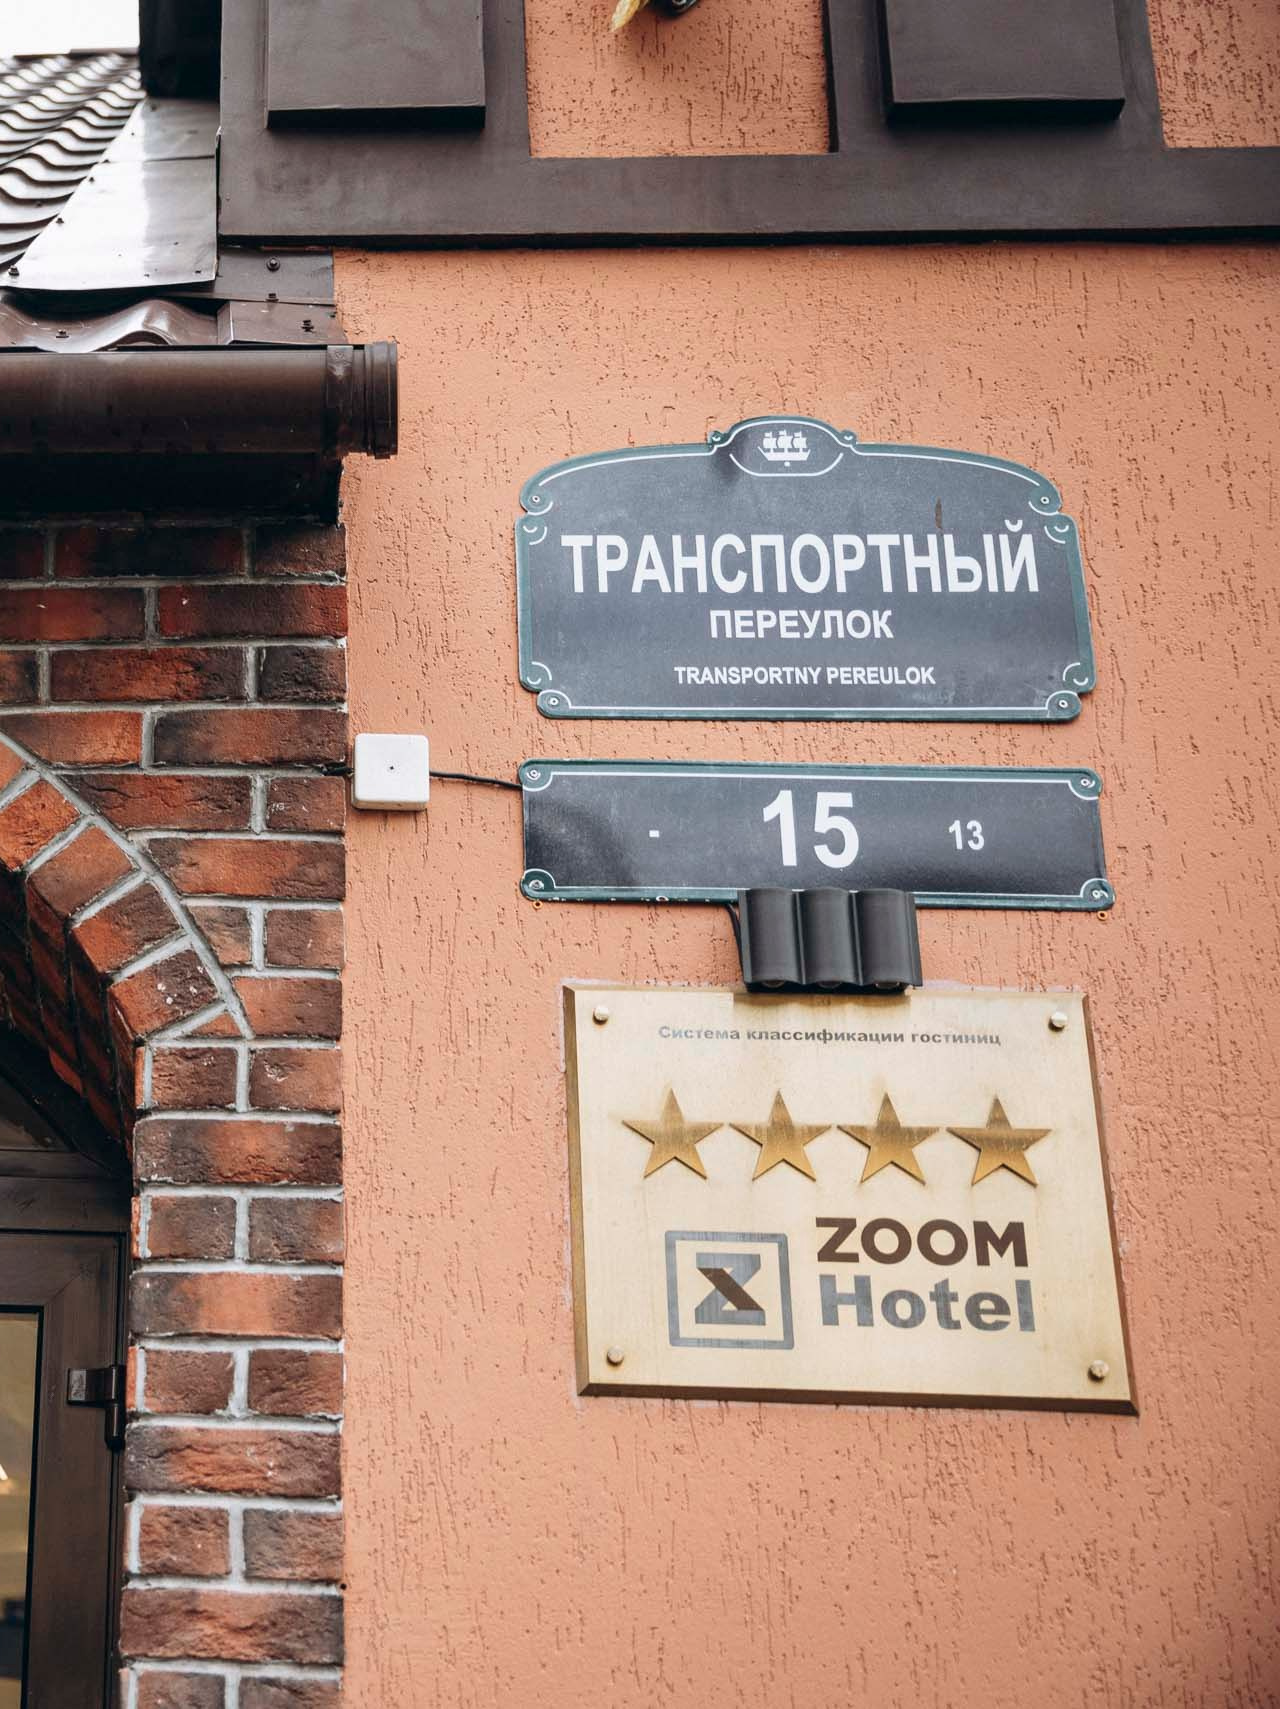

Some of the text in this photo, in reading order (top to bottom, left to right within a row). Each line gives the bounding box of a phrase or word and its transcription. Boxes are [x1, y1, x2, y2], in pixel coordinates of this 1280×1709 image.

[561, 519, 1039, 594] ТРАНСПОРТНЫЙ
[710, 609, 894, 639] ПЕРЕУЛОК
[674, 666, 936, 686] TRANSPORTNY PEREULOK
[762, 789, 859, 868] 15
[948, 820, 985, 850] 13
[658, 1025, 1001, 1046] Система классификации гостиниц
[815, 1217, 1028, 1267] ZOOM
[819, 1275, 1036, 1332] Hotel
